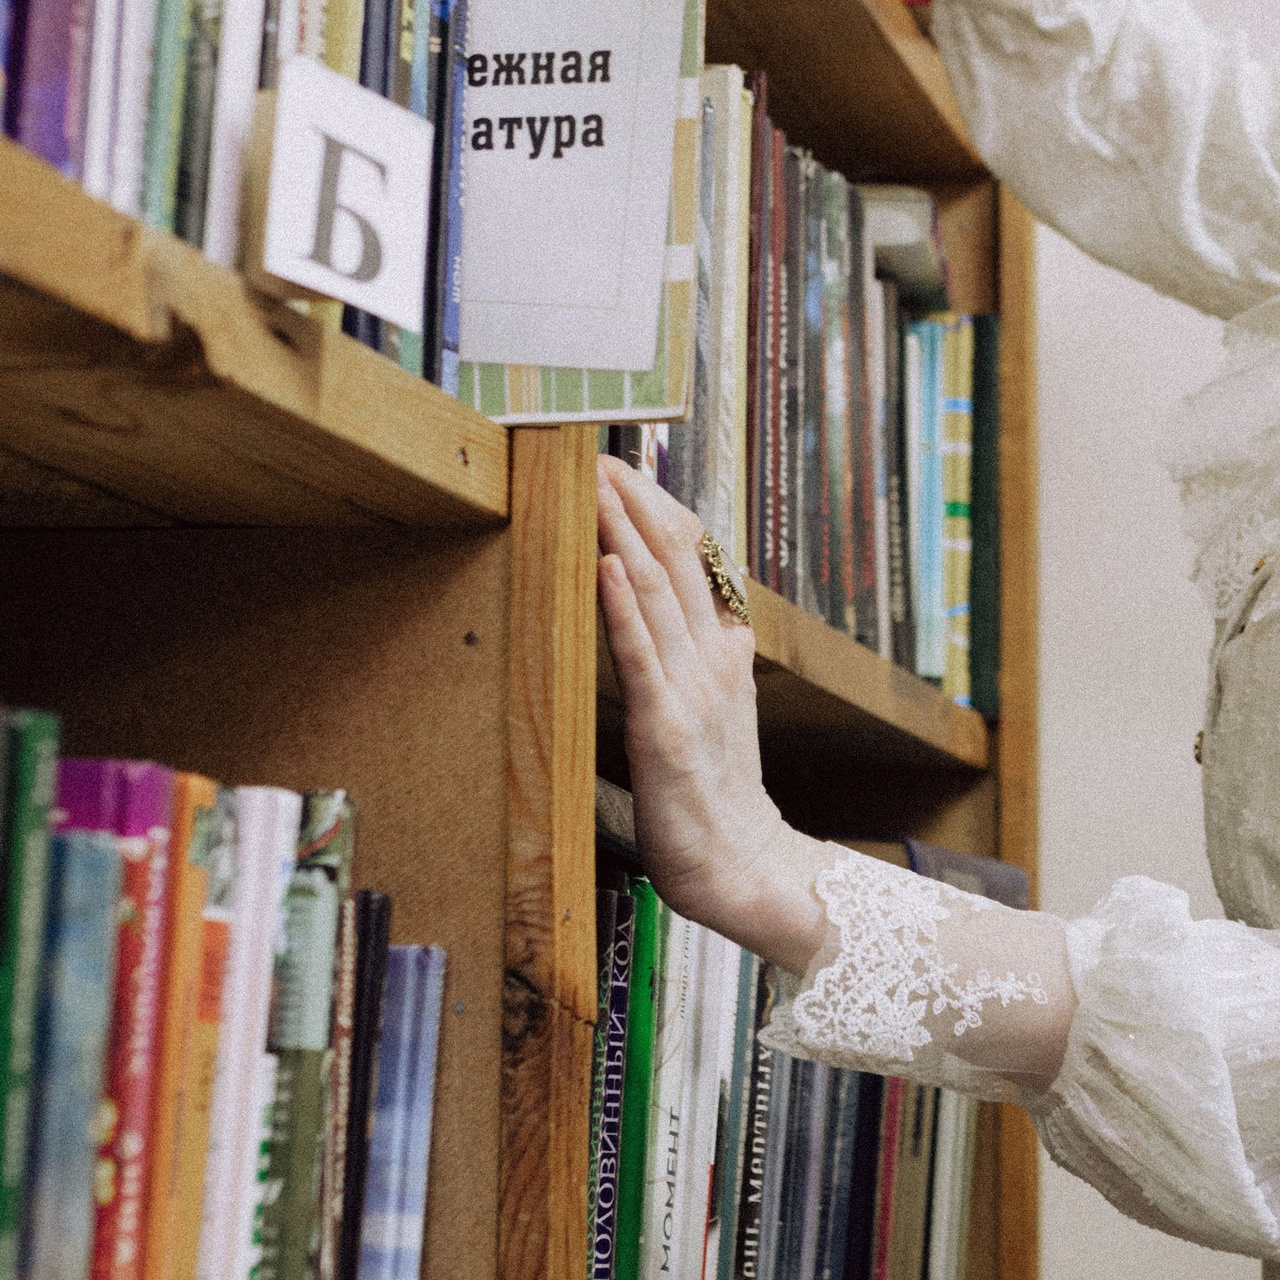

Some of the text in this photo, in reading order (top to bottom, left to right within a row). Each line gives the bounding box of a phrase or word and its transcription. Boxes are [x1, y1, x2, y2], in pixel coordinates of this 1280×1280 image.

[470, 113, 605, 160] атура
[302, 128, 388, 282] Б
[609, 914, 635, 988] КОД
[660, 1106, 679, 1272] МОМЕНТ
